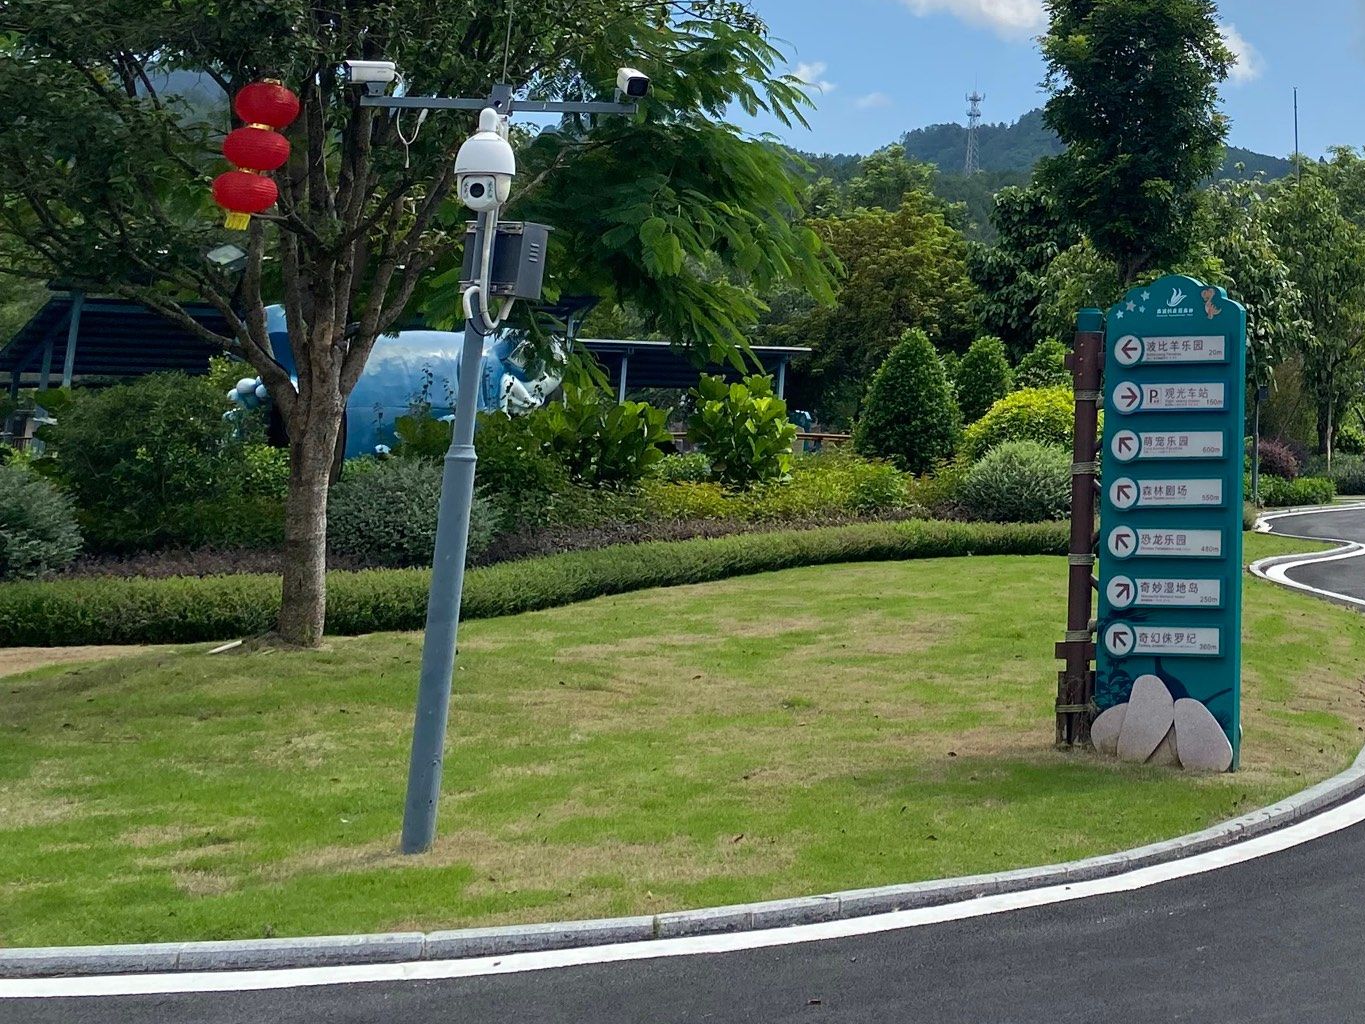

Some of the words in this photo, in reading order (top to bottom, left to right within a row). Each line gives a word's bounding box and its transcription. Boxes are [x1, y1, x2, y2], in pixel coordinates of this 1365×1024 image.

[1146, 340, 1204, 352] 波比羊乐园
[1149, 389, 1159, 404] P
[1165, 387, 1209, 399] 观光车站
[1143, 436, 1189, 447] 萌宠乐园
[1142, 485, 1188, 496] 森林剧场
[1140, 534, 1187, 546] 恐龙乐园
[1140, 581, 1199, 594] 奇妙湿地岛
[1138, 632, 1197, 644] 奇幻侏罗纪
